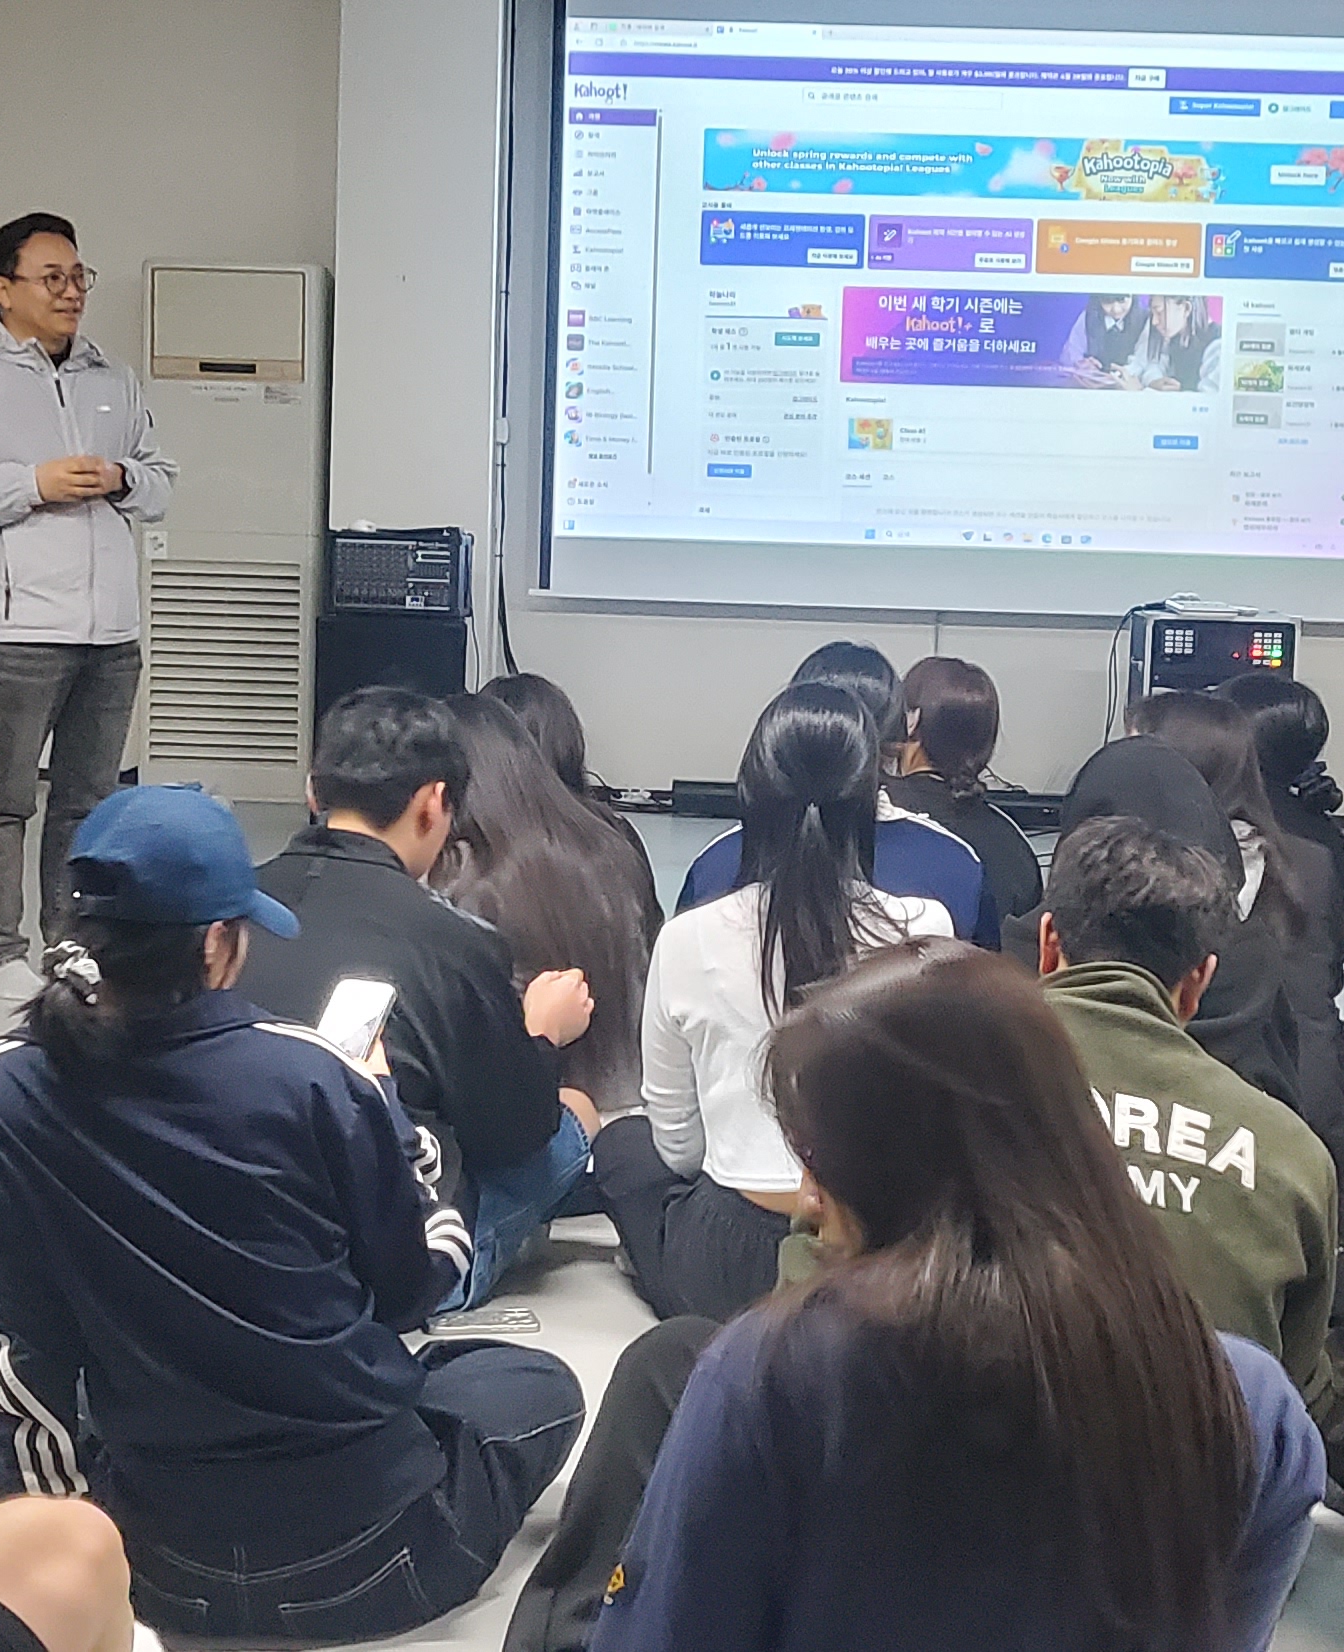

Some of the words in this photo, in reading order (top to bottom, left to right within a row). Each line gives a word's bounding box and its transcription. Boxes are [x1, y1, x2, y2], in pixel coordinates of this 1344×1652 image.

[574, 81, 628, 105] Kahoot!
[752, 148, 789, 159] Unlock
[793, 149, 826, 161] spring
[829, 151, 873, 161] rewards
[876, 152, 896, 161] and
[899, 153, 946, 164] compete
[950, 153, 973, 163] with
[752, 160, 782, 170] other
[784, 161, 823, 171] classes
[825, 162, 836, 171] in
[906, 164, 951, 175] Leagues
[1083, 153, 1174, 179] Kahootopia
[1120, 174, 1146, 184] with
[1104, 184, 1144, 194] Leagues
[878, 295, 907, 312] 이번
[912, 296, 927, 313] 새
[931, 296, 959, 313] 학기
[964, 297, 1023, 315] 시즌에는
[978, 318, 995, 334] 로
[865, 336, 901, 351] 배우는
[905, 337, 929, 352] 곳에
[932, 338, 980, 353] 즐거움을
[983, 339, 1036, 354] 더하세요!
[1091, 1086, 1256, 1190] REA
